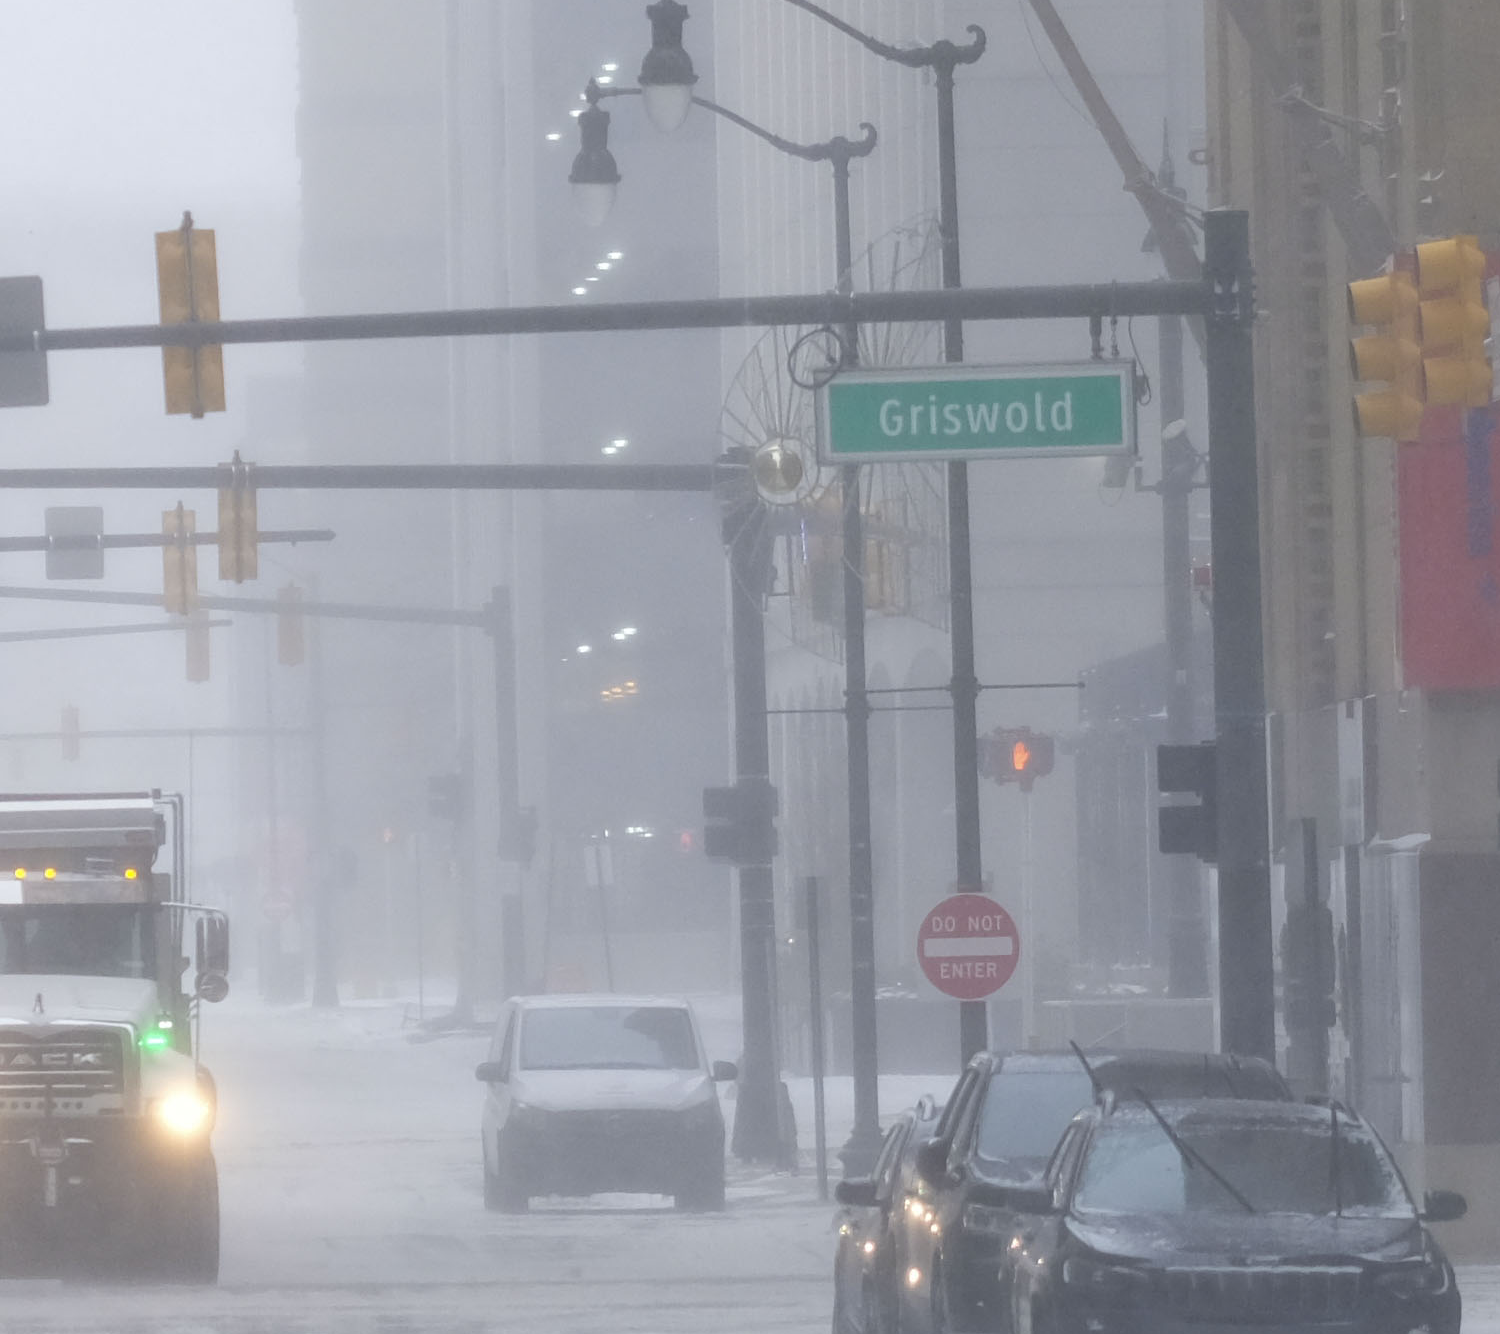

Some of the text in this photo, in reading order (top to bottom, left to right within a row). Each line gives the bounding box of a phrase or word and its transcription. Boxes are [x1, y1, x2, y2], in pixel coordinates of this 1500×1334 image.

[879, 391, 1073, 436] Griswold
[931, 914, 1003, 932] DO NOT
[940, 962, 998, 979] ENTER
